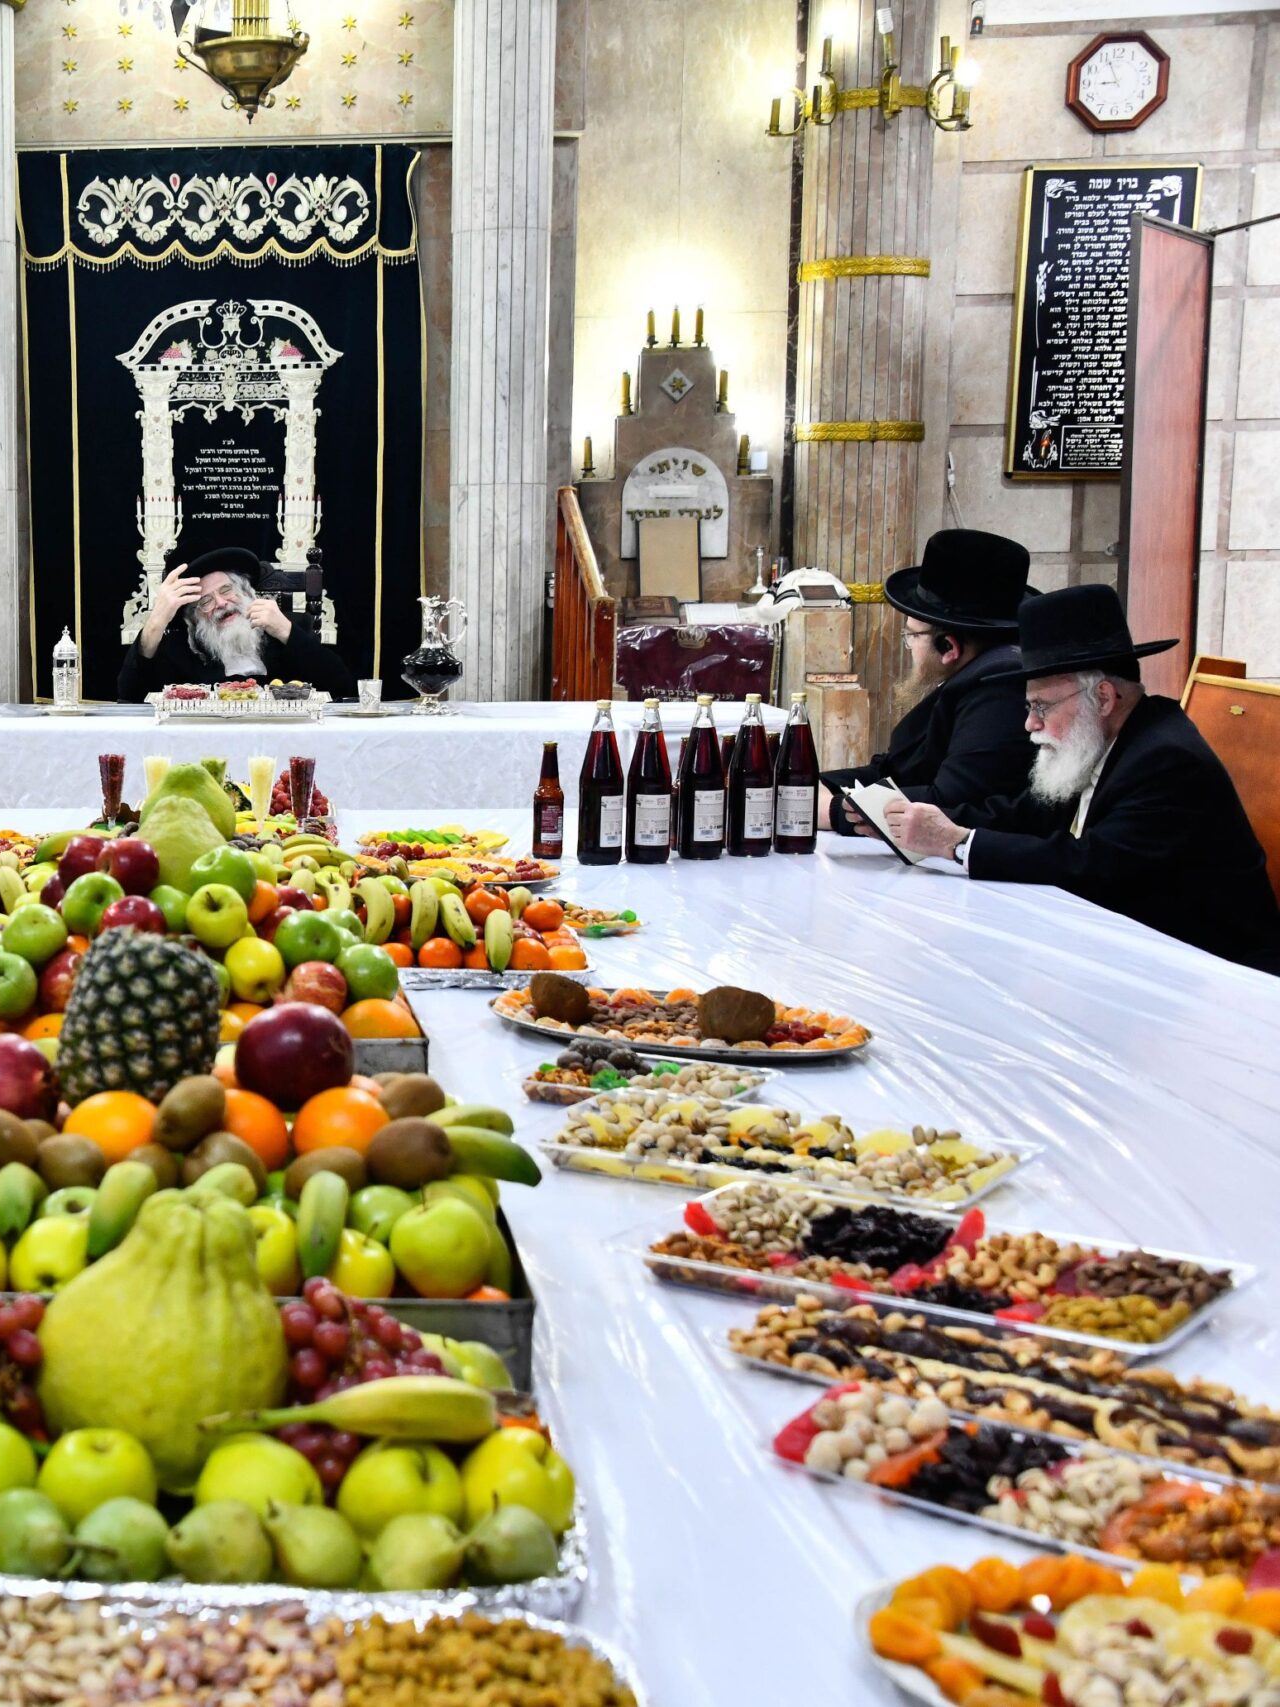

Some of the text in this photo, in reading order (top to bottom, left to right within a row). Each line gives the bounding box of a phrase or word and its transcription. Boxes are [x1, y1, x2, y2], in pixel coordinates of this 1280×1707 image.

[1100, 52, 1108, 63] 11
[1113, 48, 1125, 58] 12
[1087, 64, 1097, 75] 10
[1139, 62, 1148, 72] 2
[1082, 79, 1091, 89] 9
[1142, 75, 1151, 85] 3
[1086, 92, 1095, 102] 8
[1137, 90, 1144, 100] 4
[1096, 104, 1104, 114] 7
[1110, 106, 1119, 116] 6
[1125, 102, 1133, 113] 5
[1089, 178, 1138, 191] בריך שמה
[678, 505, 723, 520] לנגדי
